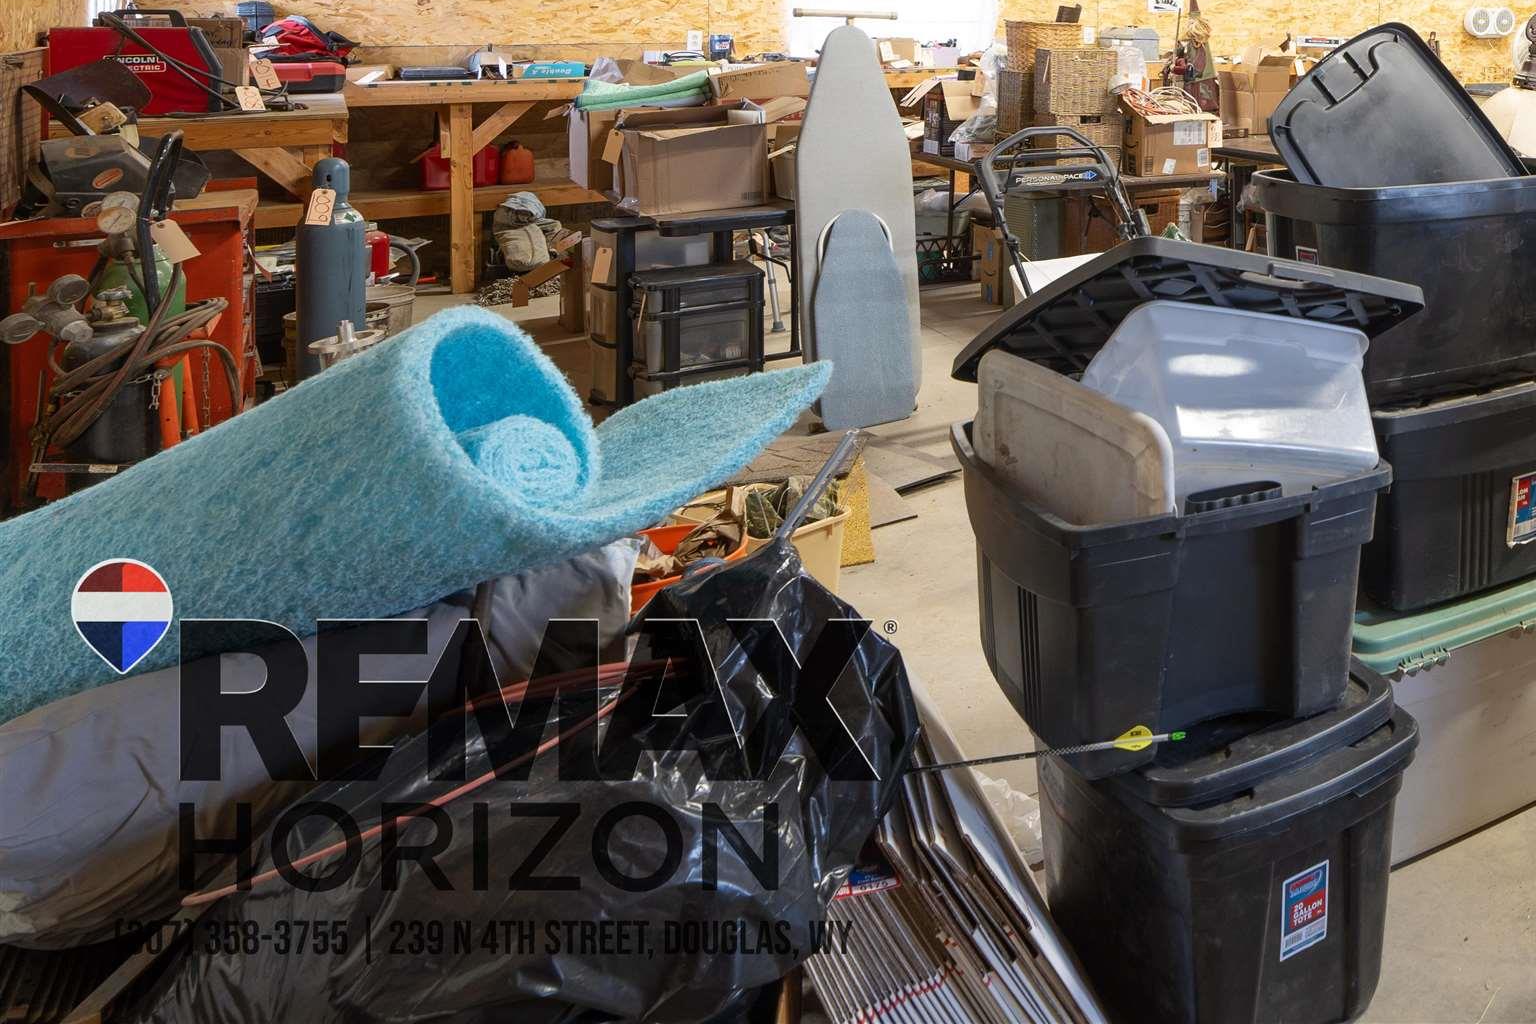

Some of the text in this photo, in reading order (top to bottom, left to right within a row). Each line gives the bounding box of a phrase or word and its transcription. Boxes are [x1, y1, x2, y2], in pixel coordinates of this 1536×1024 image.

[115, 56, 156, 64] NCOLN
[1293, 898, 1323, 920] GALLON
[1293, 911, 1313, 926] TOTE
